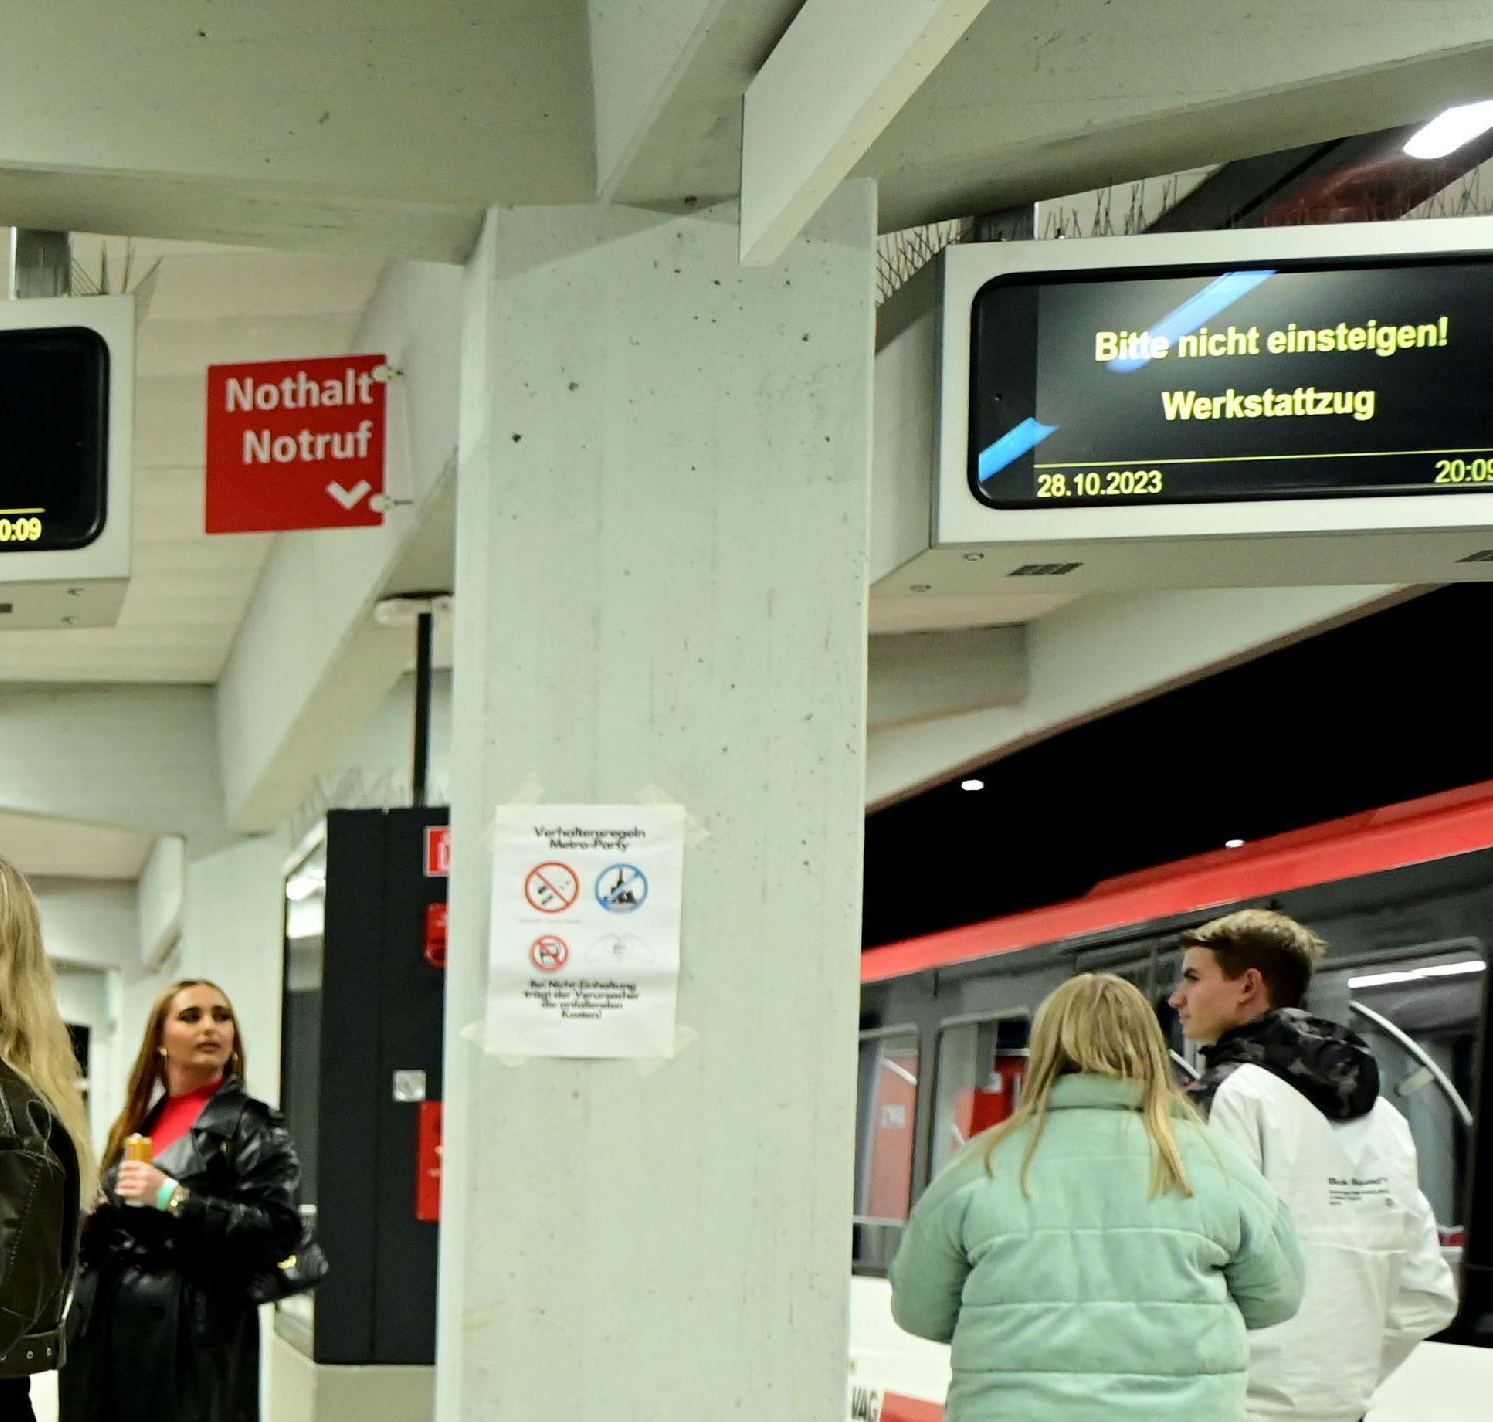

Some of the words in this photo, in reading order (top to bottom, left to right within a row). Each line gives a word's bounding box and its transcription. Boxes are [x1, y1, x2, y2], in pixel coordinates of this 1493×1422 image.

[1095, 331, 1169, 361] Bitte
[1178, 326, 1260, 358] nicht
[1267, 316, 1449, 357] einsteigen!
[225, 367, 374, 413] Nothalt
[1161, 387, 1376, 421] Werkstattzug
[242, 419, 373, 464] Notruf
[1037, 470, 1163, 498] 28.10.2023
[549, 837, 630, 853] Metro-Party
